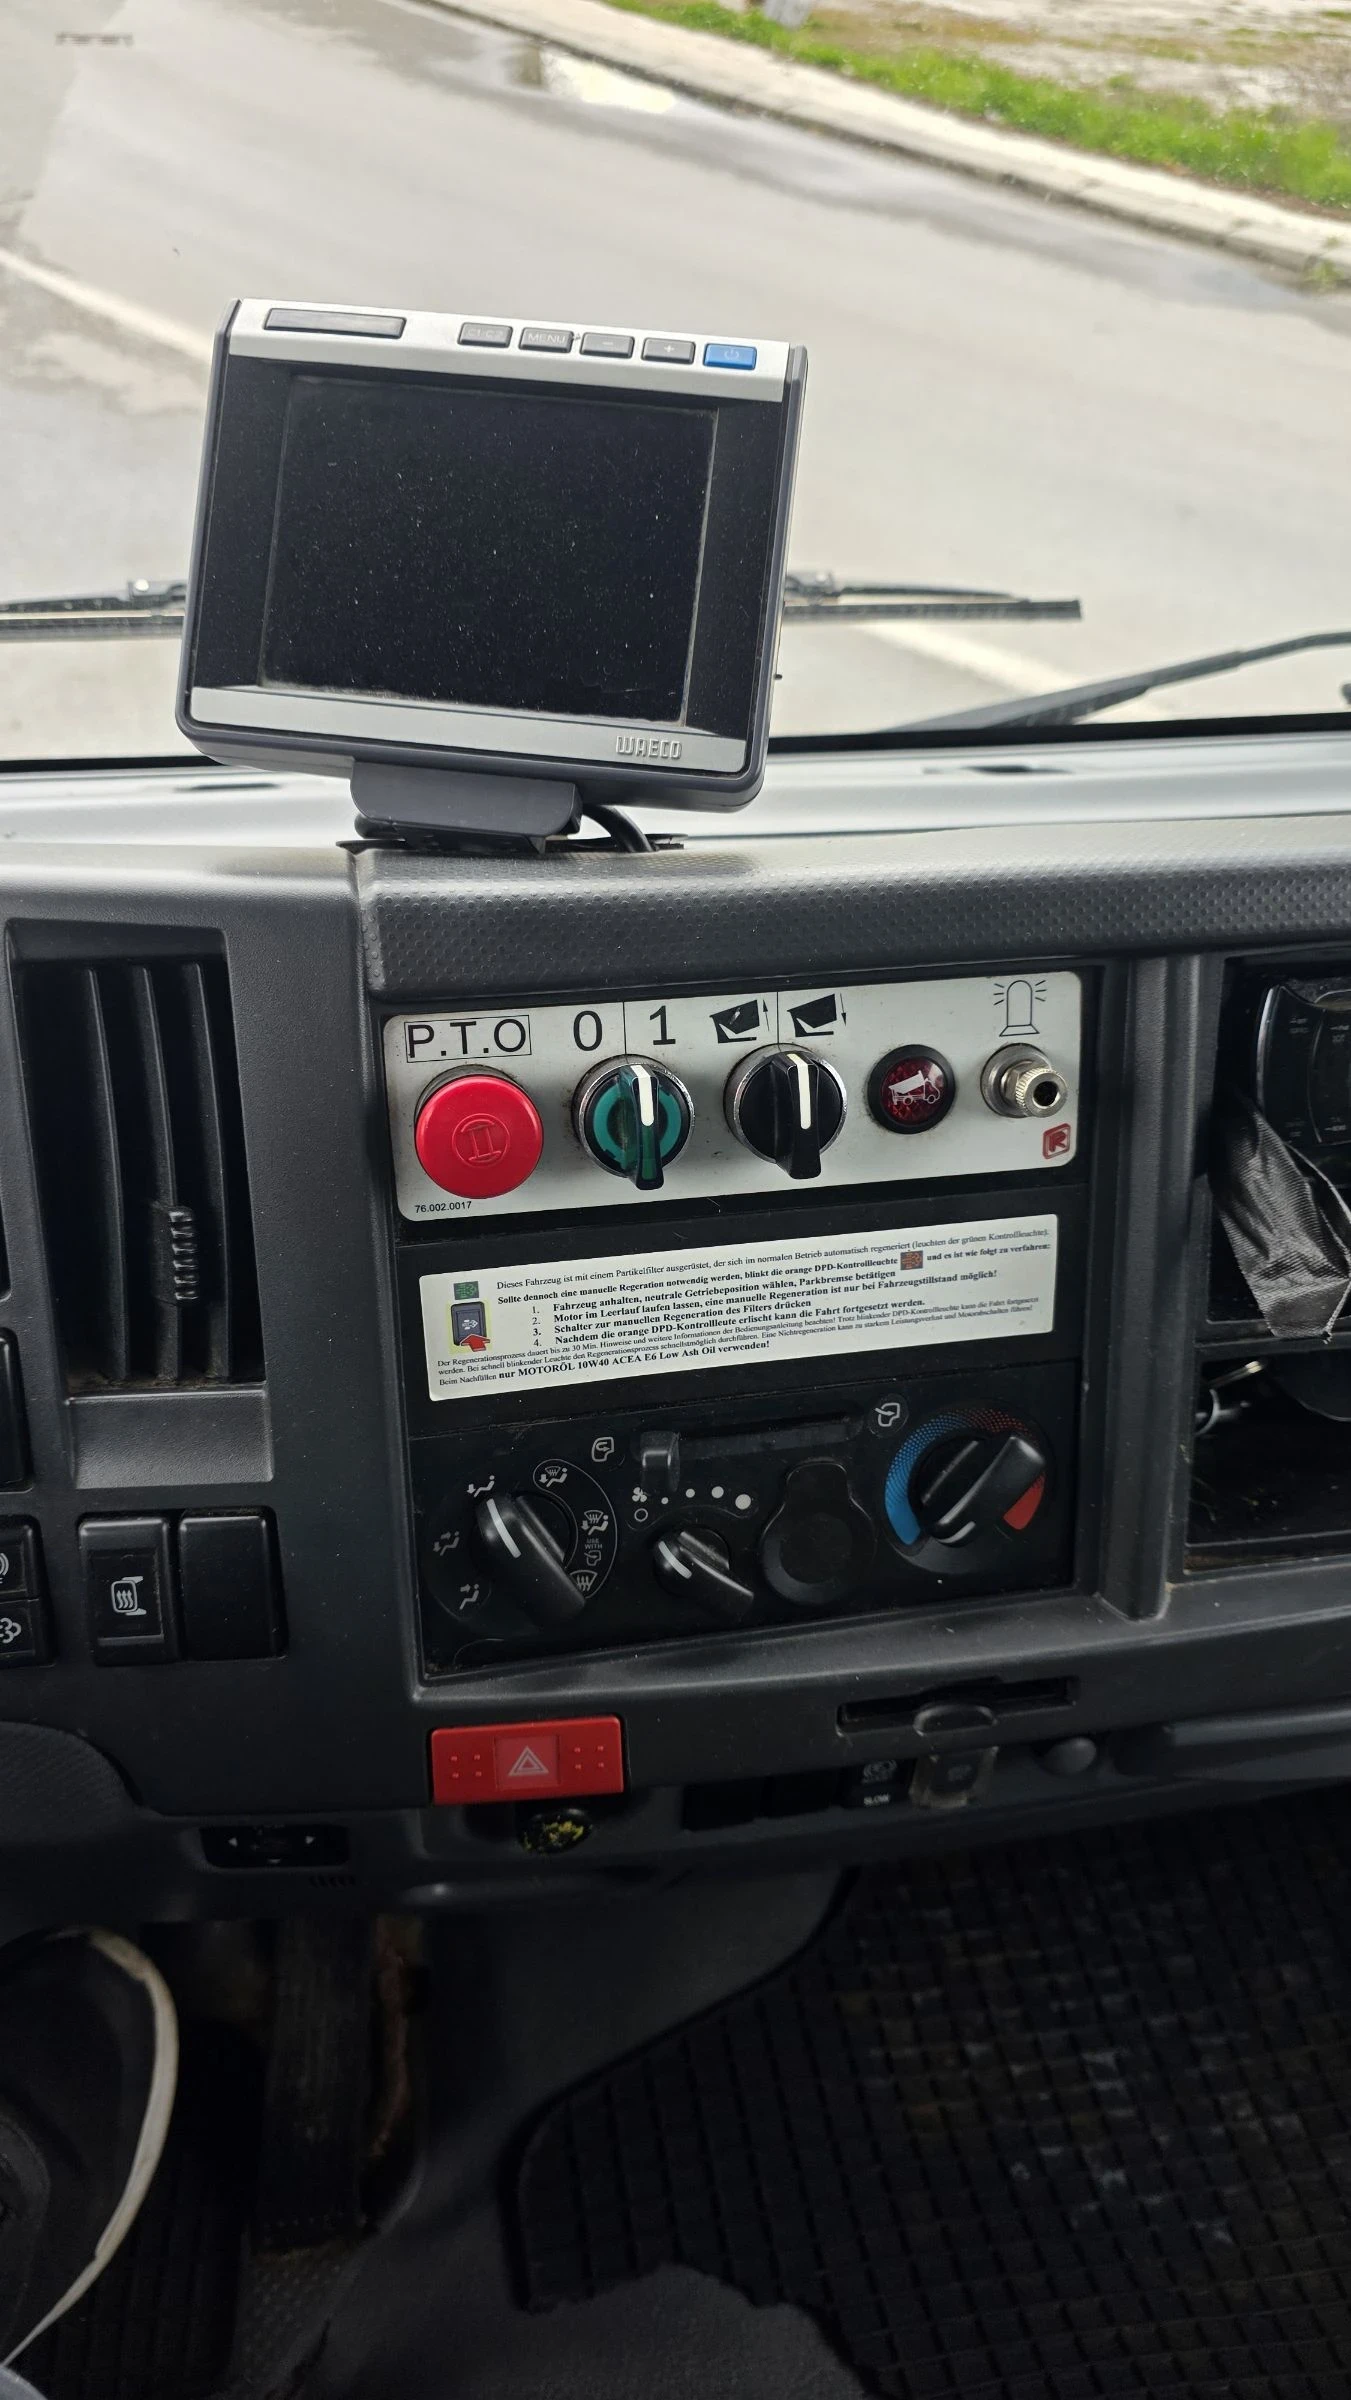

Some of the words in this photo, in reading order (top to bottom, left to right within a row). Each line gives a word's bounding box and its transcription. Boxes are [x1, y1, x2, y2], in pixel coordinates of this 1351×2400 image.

[528, 333, 567, 344] MENU
[615, 735, 683, 759] WAECO
[408, 1019, 527, 1058] P.T.O
[573, 1010, 603, 1051] 0
[650, 1005, 676, 1045] 1
[414, 1200, 473, 1214] 76.002.0017
[497, 1279, 522, 1289] Dieses
[525, 1275, 561, 1287] Fahrzeug
[563, 1274, 572, 1282] ist
[574, 1273, 587, 1281] mit
[589, 1272, 613, 1280] einem
[616, 1265, 664, 1277] Partikelfilter
[666, 1261, 712, 1273] ausgerüstet,
[713, 1259, 725, 1267] der
[727, 1257, 742, 1266] sich
[757, 1253, 792, 1263] normalen
[794, 1250, 822, 1259] Betrieb
[824, 1245, 868, 1256] automatisch
[870, 1243, 909, 1254] regeneriert
[912, 1238, 946, 1248] (leuchten
[947, 1236, 960, 1245] der
[927, 1253, 941, 1261] und
[953, 1250, 962, 1258] ist
[965, 1249, 977, 1257] wie
[980, 1247, 997, 1257] folgt
[1010, 1242, 1050, 1252] verfahren:
[497, 1294, 521, 1304] Sollte
[523, 1291, 558, 1301] dennoch
[560, 1289, 577, 1297] eine
[579, 1285, 617, 1295] manuelle
[619, 1280, 663, 1292] Regeration
[666, 1275, 708, 1288] notwendig
[710, 1272, 743, 1282] werden,
[744, 1269, 768, 1278] blinkt
[770, 1268, 782, 1276] die
[784, 1267, 812, 1276] orange
[532, 1305, 540, 1313] 1.
[553, 1299, 597, 1313] Fahrzeug
[599, 1294, 643, 1306] anhalten,
[644, 1290, 682, 1301] neutrale
[684, 1282, 759, 1299] Getriebeposition
[762, 1279, 797, 1289] wählen,
[799, 1273, 852, 1286] Parkbremse
[855, 1269, 895, 1282] betätigen
[532, 1316, 541, 1324] 2.
[554, 1311, 583, 1322] Motor
[585, 1310, 597, 1318] im
[600, 1305, 640, 1317] Leerlauf
[642, 1302, 670, 1313] laufen
[673, 1299, 703, 1310] lassen,
[705, 1297, 723, 1306] eine
[726, 1292, 766, 1304] manuelle
[769, 1286, 828, 1301] Regeneration
[830, 1285, 840, 1293] ist
[844, 1285, 859, 1293] nur
[862, 1281, 874, 1290] bei
[878, 1273, 957, 1290] Fahrzeugstillstand
[960, 1269, 997, 1282] möglich!
[532, 1327, 542, 1336] 3.
[554, 1321, 593, 1333] Schalter
[595, 1321, 611, 1329] zur
[613, 1314, 660, 1326] manuellen
[663, 1307, 722, 1323] Regeneration
[725, 1305, 740, 1315] des
[743, 1302, 771, 1313] Filters
[774, 1298, 811, 1309] drücken
[533, 1338, 542, 1346] 4.
[555, 1332, 598, 1344] Nachdem
[601, 1330, 614, 1339] die
[617, 1328, 649, 1338] orange
[738, 1313, 771, 1324] erlischt
[774, 1310, 796, 1320] kann
[799, 1309, 812, 1318] die
[815, 1306, 839, 1316] Fahrt
[843, 1301, 888, 1315] fortgesetzt
[891, 1298, 925, 1308] werden.
[439, 1377, 457, 1385] Beim
[459, 1373, 496, 1383] Nachfüllen
[498, 1371, 515, 1379] nur
[518, 1361, 575, 1376] MOTORÖL
[578, 1358, 609, 1369] 10W40
[612, 1354, 641, 1364] ACEA
[644, 1352, 656, 1361] E6
[659, 1350, 678, 1359] Low
[682, 1348, 698, 1356] Ash
[701, 1345, 715, 1354] Oil
[718, 1340, 770, 1352] verwenden!
